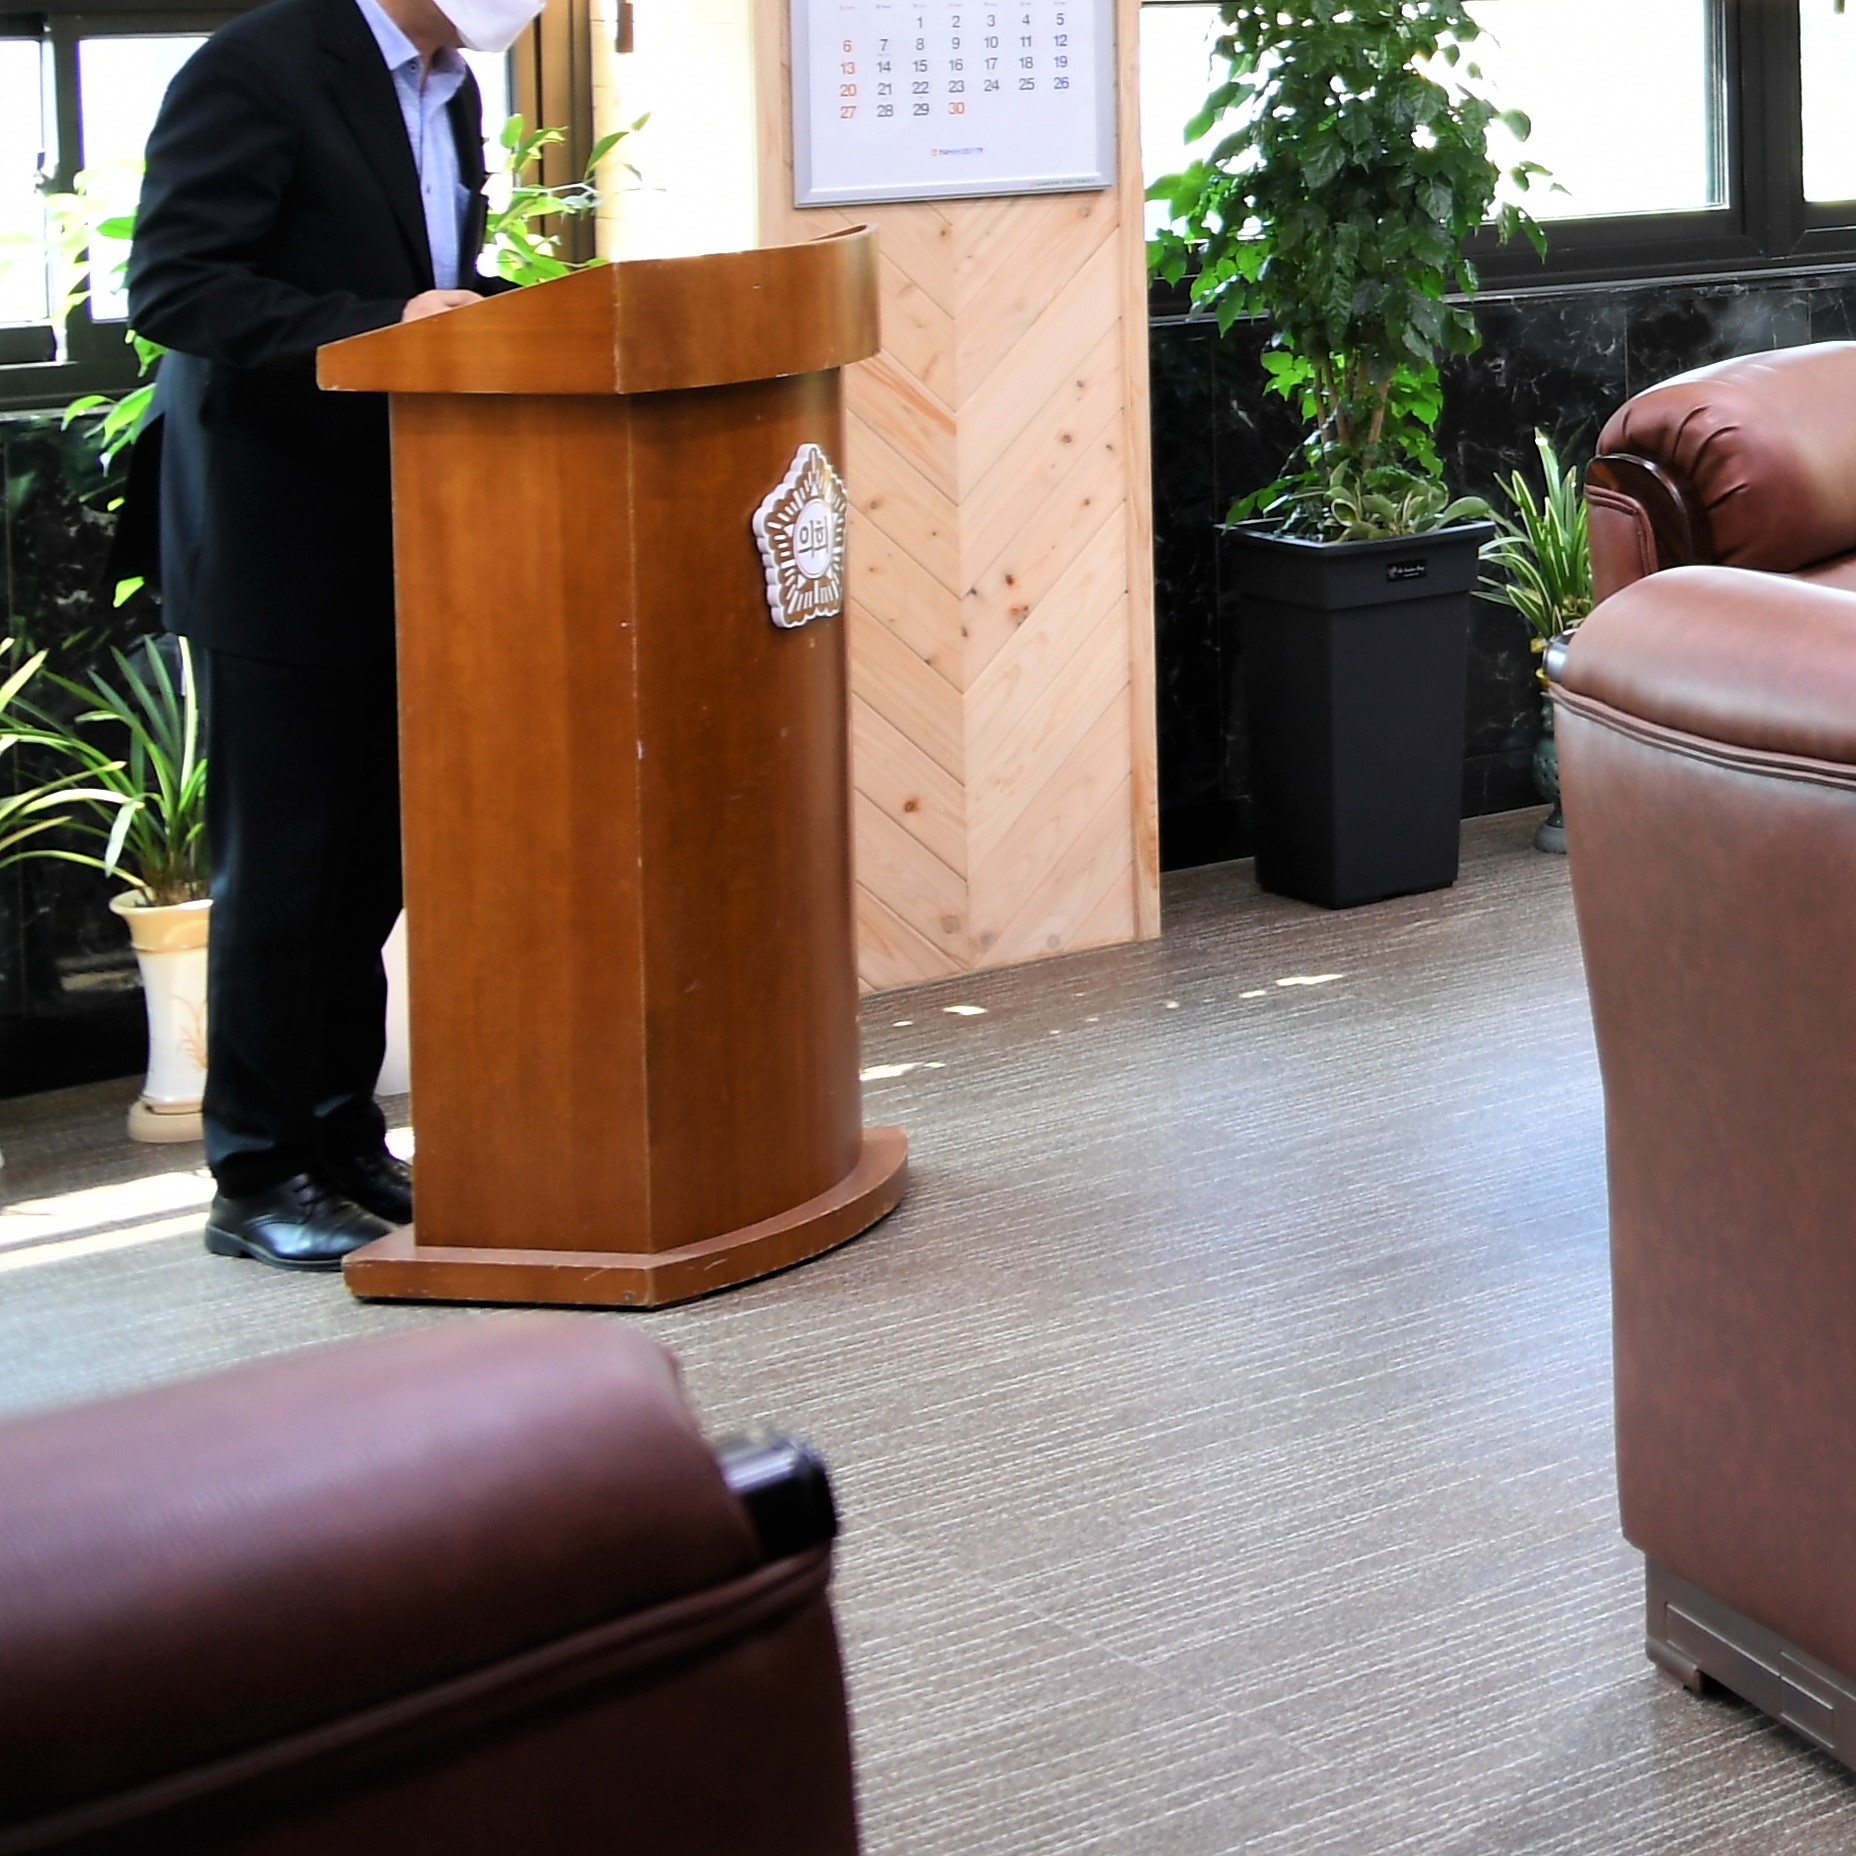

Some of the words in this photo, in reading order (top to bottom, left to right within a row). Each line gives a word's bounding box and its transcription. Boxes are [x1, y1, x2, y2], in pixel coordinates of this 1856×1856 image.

[951, 15, 961, 29] 2
[987, 14, 996, 28] 3
[1021, 13, 1031, 25] 4
[1056, 13, 1065, 26] 5
[842, 39, 852, 53] 6
[879, 38, 889, 52] 7
[915, 37, 925, 51] 8
[951, 36, 961, 50] 9
[983, 35, 999, 49] 10
[1019, 35, 1032, 48] 11
[1053, 33, 1068, 47] 12
[840, 61, 856, 75] 13
[876, 60, 892, 73] 14
[912, 59, 928, 73] 15
[948, 58, 964, 72] 16
[984, 56, 999, 70] 17
[1019, 56, 1034, 70] 18
[1053, 55, 1068, 69] 19
[839, 83, 858, 98] 20
[877, 82, 892, 96] 21
[912, 80, 930, 95] 22
[948, 79, 966, 94] 23
[983, 78, 1000, 92] 24
[1018, 77, 1036, 91] 25
[1053, 76, 1070, 90] 26
[839, 105, 857, 120] 27
[876, 103, 894, 118] 28
[912, 102, 930, 117] 29
[948, 101, 966, 115] 30
[797, 514, 830, 560] 의회
